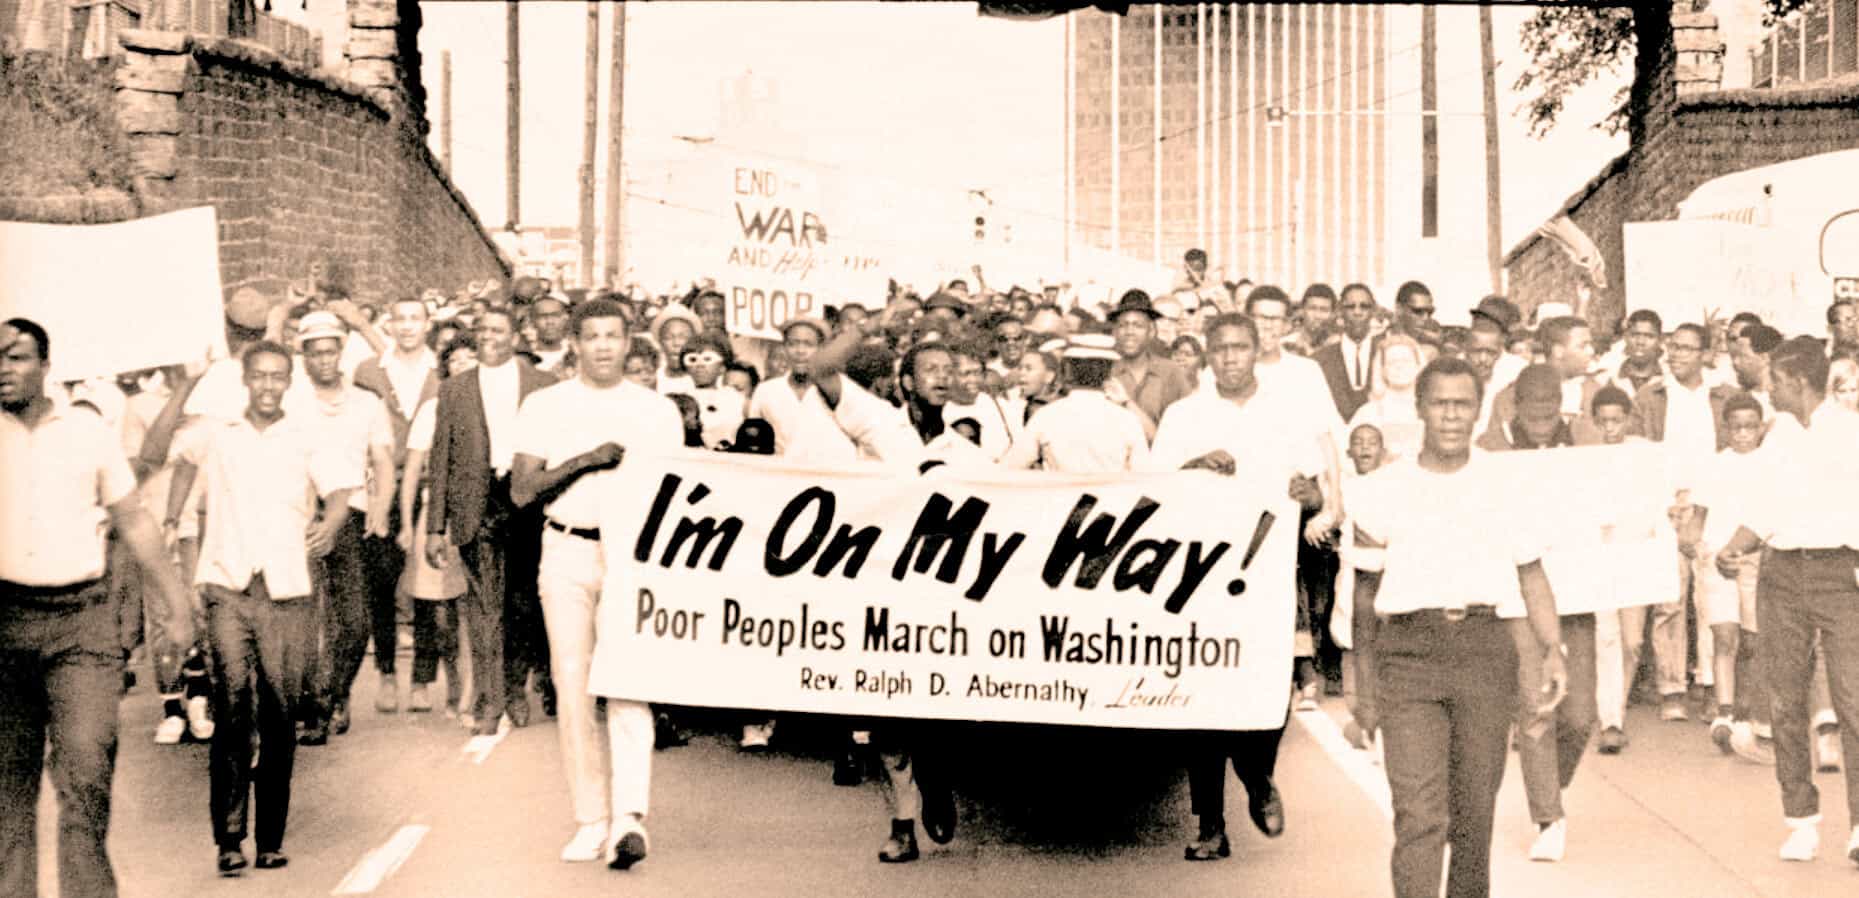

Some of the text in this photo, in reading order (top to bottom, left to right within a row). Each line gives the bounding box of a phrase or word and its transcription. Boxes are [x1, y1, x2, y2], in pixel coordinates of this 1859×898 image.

[735, 167, 777, 198] END
[734, 201, 820, 249] WAR
[727, 247, 769, 268] AND
[633, 473, 1276, 615] I'm On My Way!
[636, 587, 1241, 679] Poor Peoples March on Washington
[800, 666, 843, 692] Rev.
[854, 668, 913, 701] Ralph
[929, 671, 951, 697] D.
